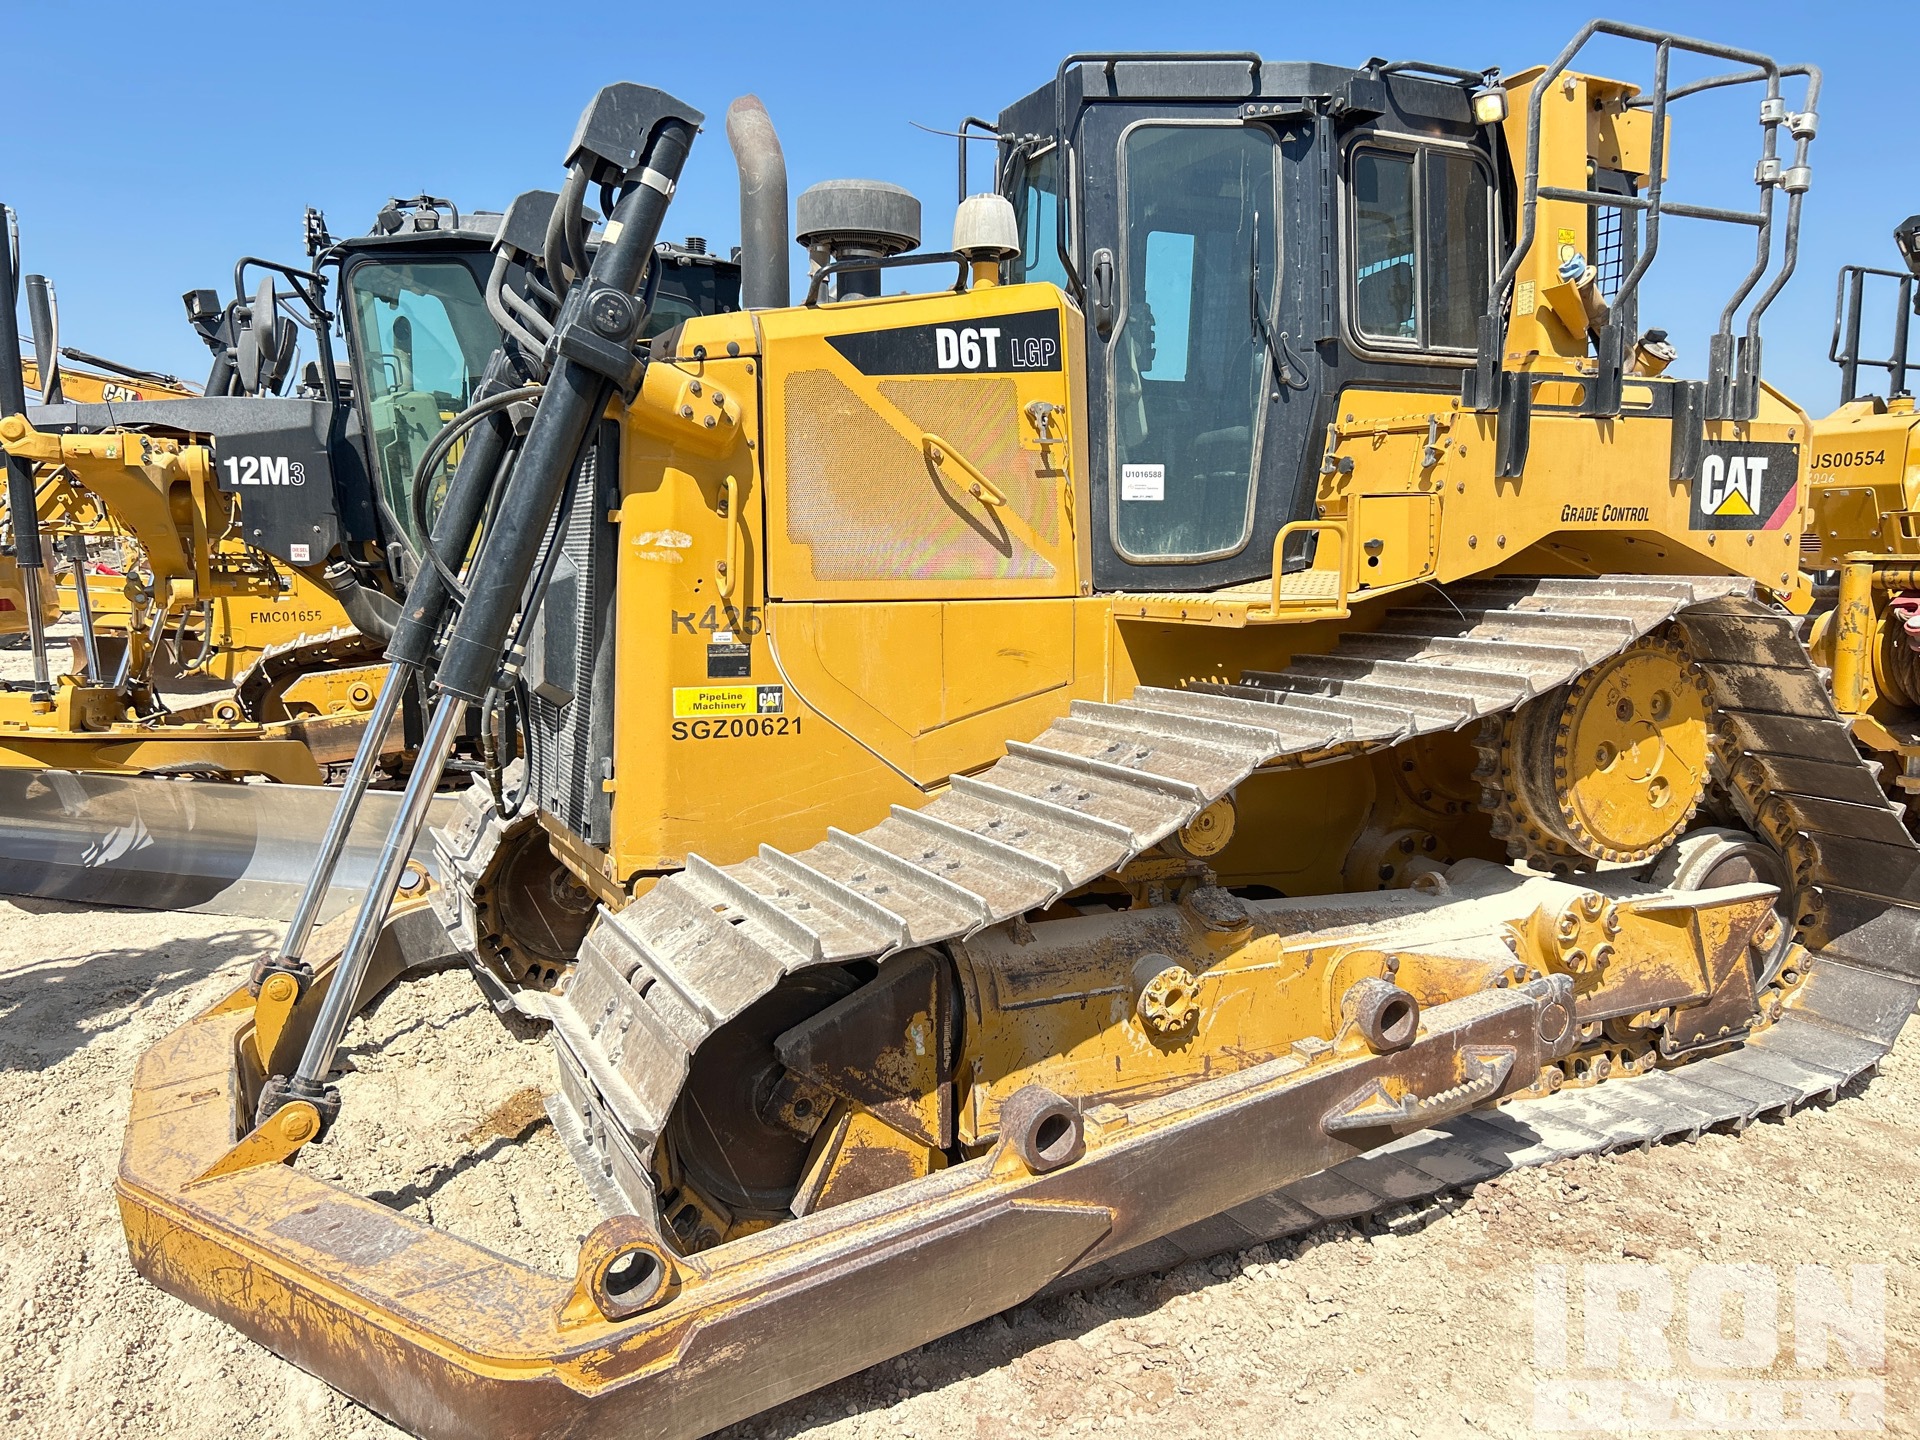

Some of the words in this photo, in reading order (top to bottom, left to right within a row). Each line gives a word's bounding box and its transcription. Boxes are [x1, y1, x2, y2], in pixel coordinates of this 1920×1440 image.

[935, 327, 1001, 369] D6T
[1010, 337, 1056, 367] LGP
[102, 383, 137, 402] CAT
[1811, 449, 1885, 469] JS00554
[1125, 470, 1162, 478] U1016588
[1700, 454, 1769, 516] CAT
[250, 610, 322, 623] FMC01655
[671, 604, 762, 635] R425
[692, 702, 746, 711] Machinery
[699, 692, 743, 702] PipeLine
[759, 692, 781, 707] CAT
[671, 716, 801, 741] SGZ00621
